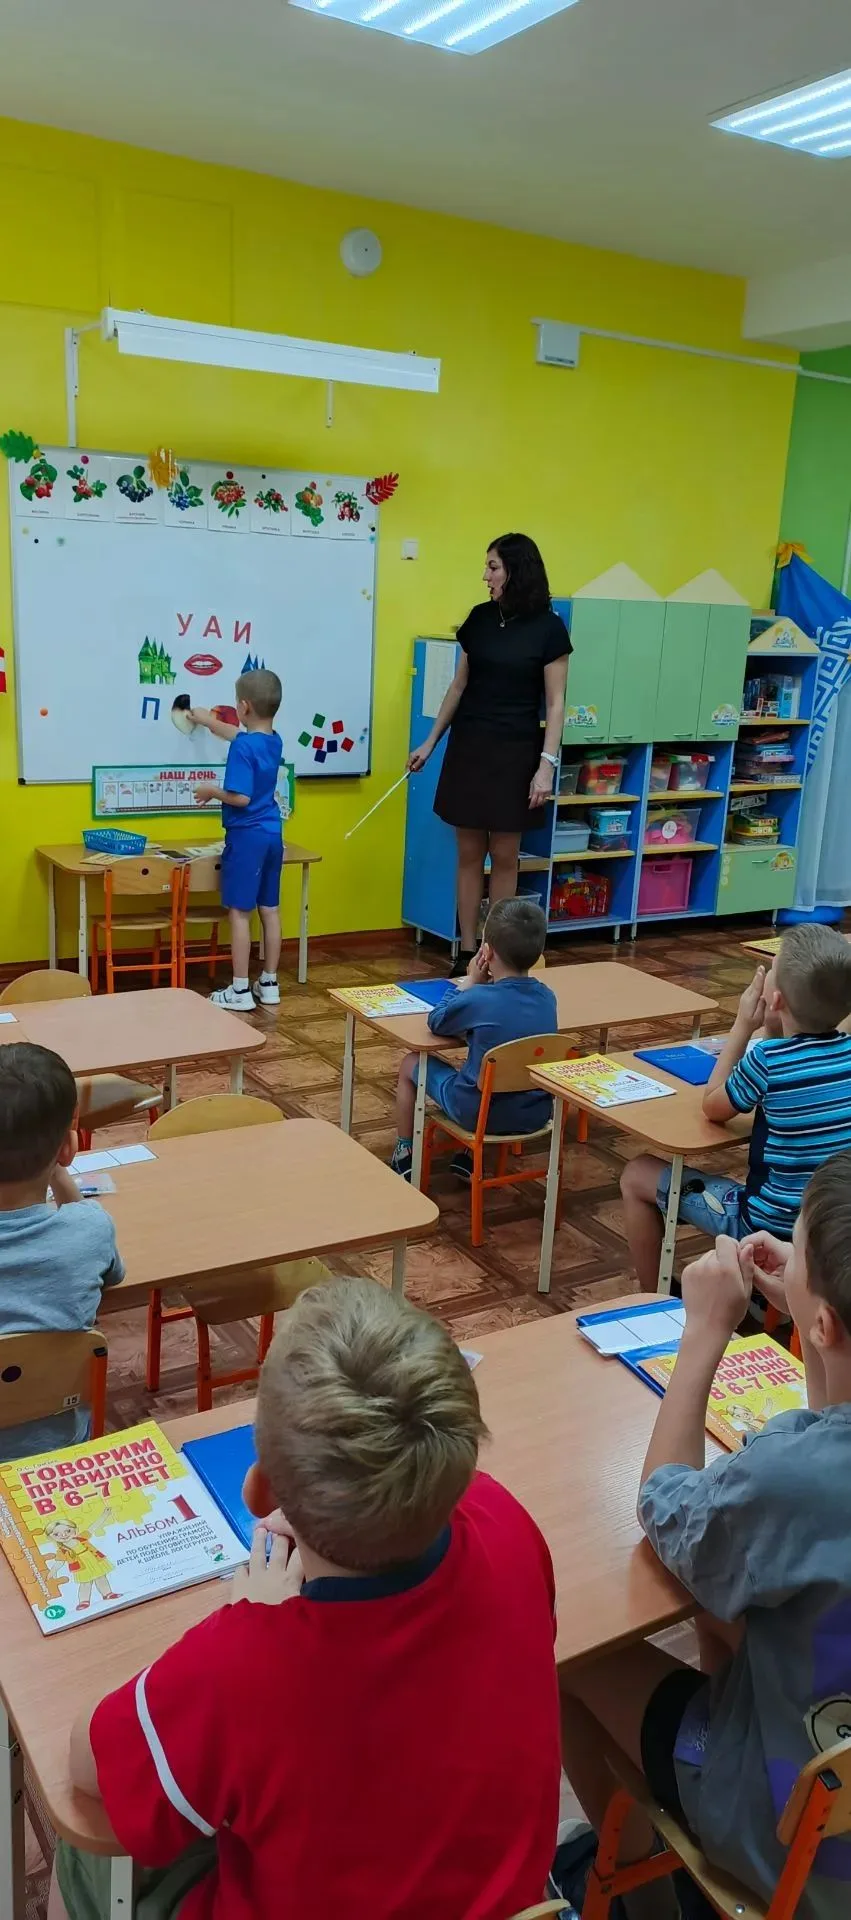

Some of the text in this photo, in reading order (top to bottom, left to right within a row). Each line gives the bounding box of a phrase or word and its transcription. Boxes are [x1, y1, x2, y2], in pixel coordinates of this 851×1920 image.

[141, 696, 160, 721] П
[160, 771, 185, 780] НАШ
[765, 1367, 804, 1386] ЛЕТ
[20, 1438, 156, 1485] ГОВОРИМ
[26, 1452, 163, 1499] ПРАВИЛЬНО
[34, 1498, 57, 1515] В
[121, 1464, 170, 1491] ЛЕТ
[168, 1494, 201, 1522] 1
[117, 1516, 179, 1543] АЛЬБОМ
[126, 1525, 211, 1556] ПО ОБУЧЕНИЮ ГРАМОТЕ
[158, 1520, 207, 1539] УПРАЖНЕНИЙ
[117, 1530, 214, 1566] ДЕТЕЙ ПОДГОТОВИТЕЛЬНОЙ
[143, 1551, 170, 1563] ШКОЛЕ
[171, 1535, 218, 1554] ЛОГОГРУППЫ
